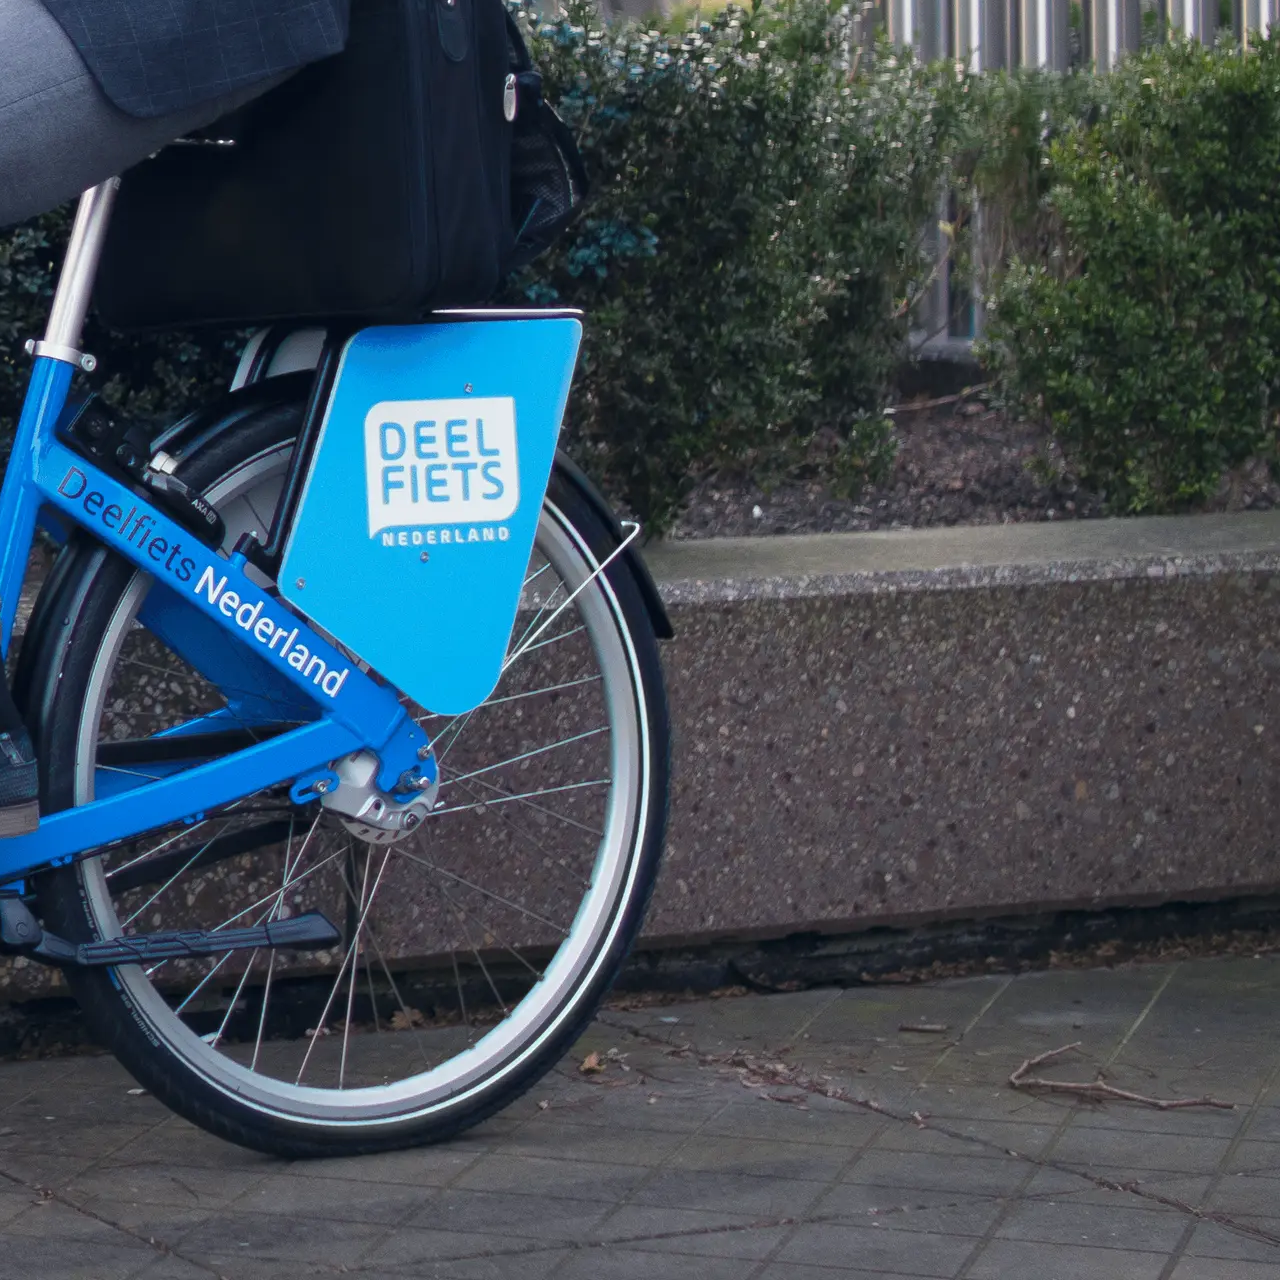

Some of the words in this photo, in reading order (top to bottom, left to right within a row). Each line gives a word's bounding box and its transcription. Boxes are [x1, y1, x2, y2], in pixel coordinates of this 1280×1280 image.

[379, 418, 500, 461] DEEL
[381, 460, 504, 505] FIETS
[191, 498, 208, 516] AXA
[382, 526, 510, 547] NEDERLAND
[56, 465, 196, 582] Deelfiets
[193, 565, 350, 698] Nederland
